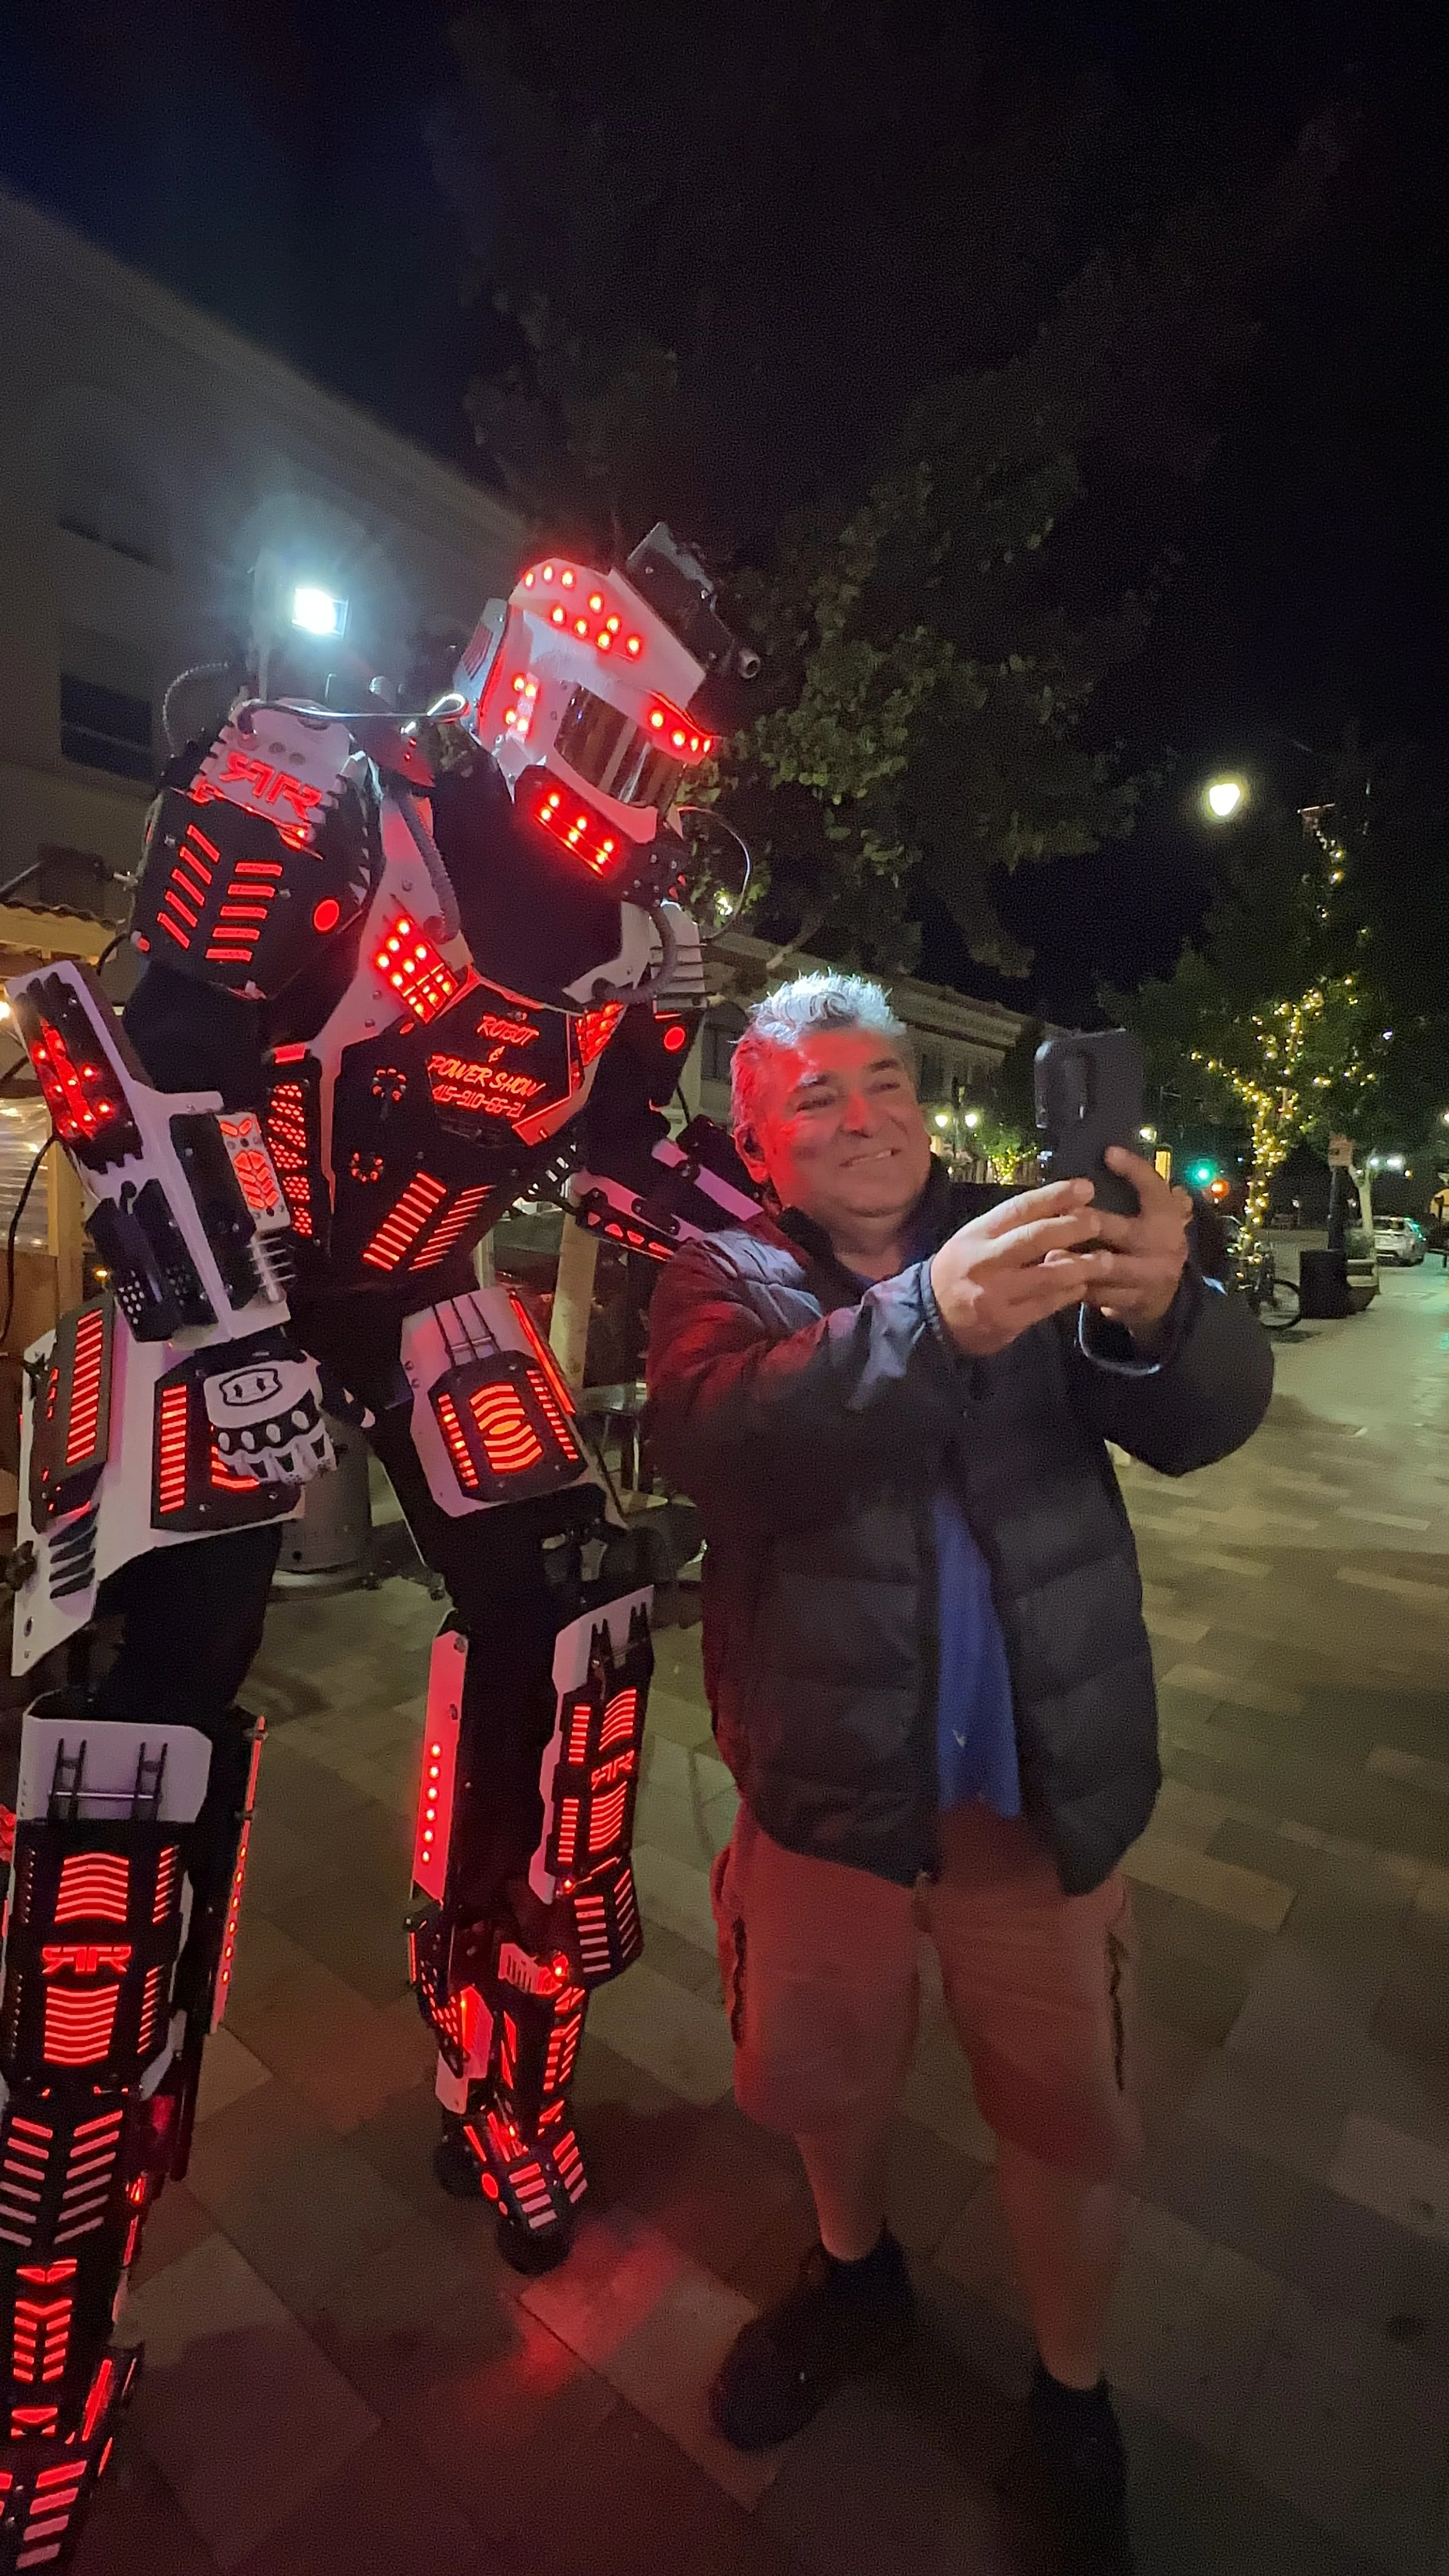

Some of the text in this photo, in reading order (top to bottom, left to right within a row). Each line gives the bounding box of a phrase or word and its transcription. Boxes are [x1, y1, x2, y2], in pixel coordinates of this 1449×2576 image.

[477, 1016, 540, 1046] ROBOT
[427, 1055, 547, 1097] POWER SHOW
